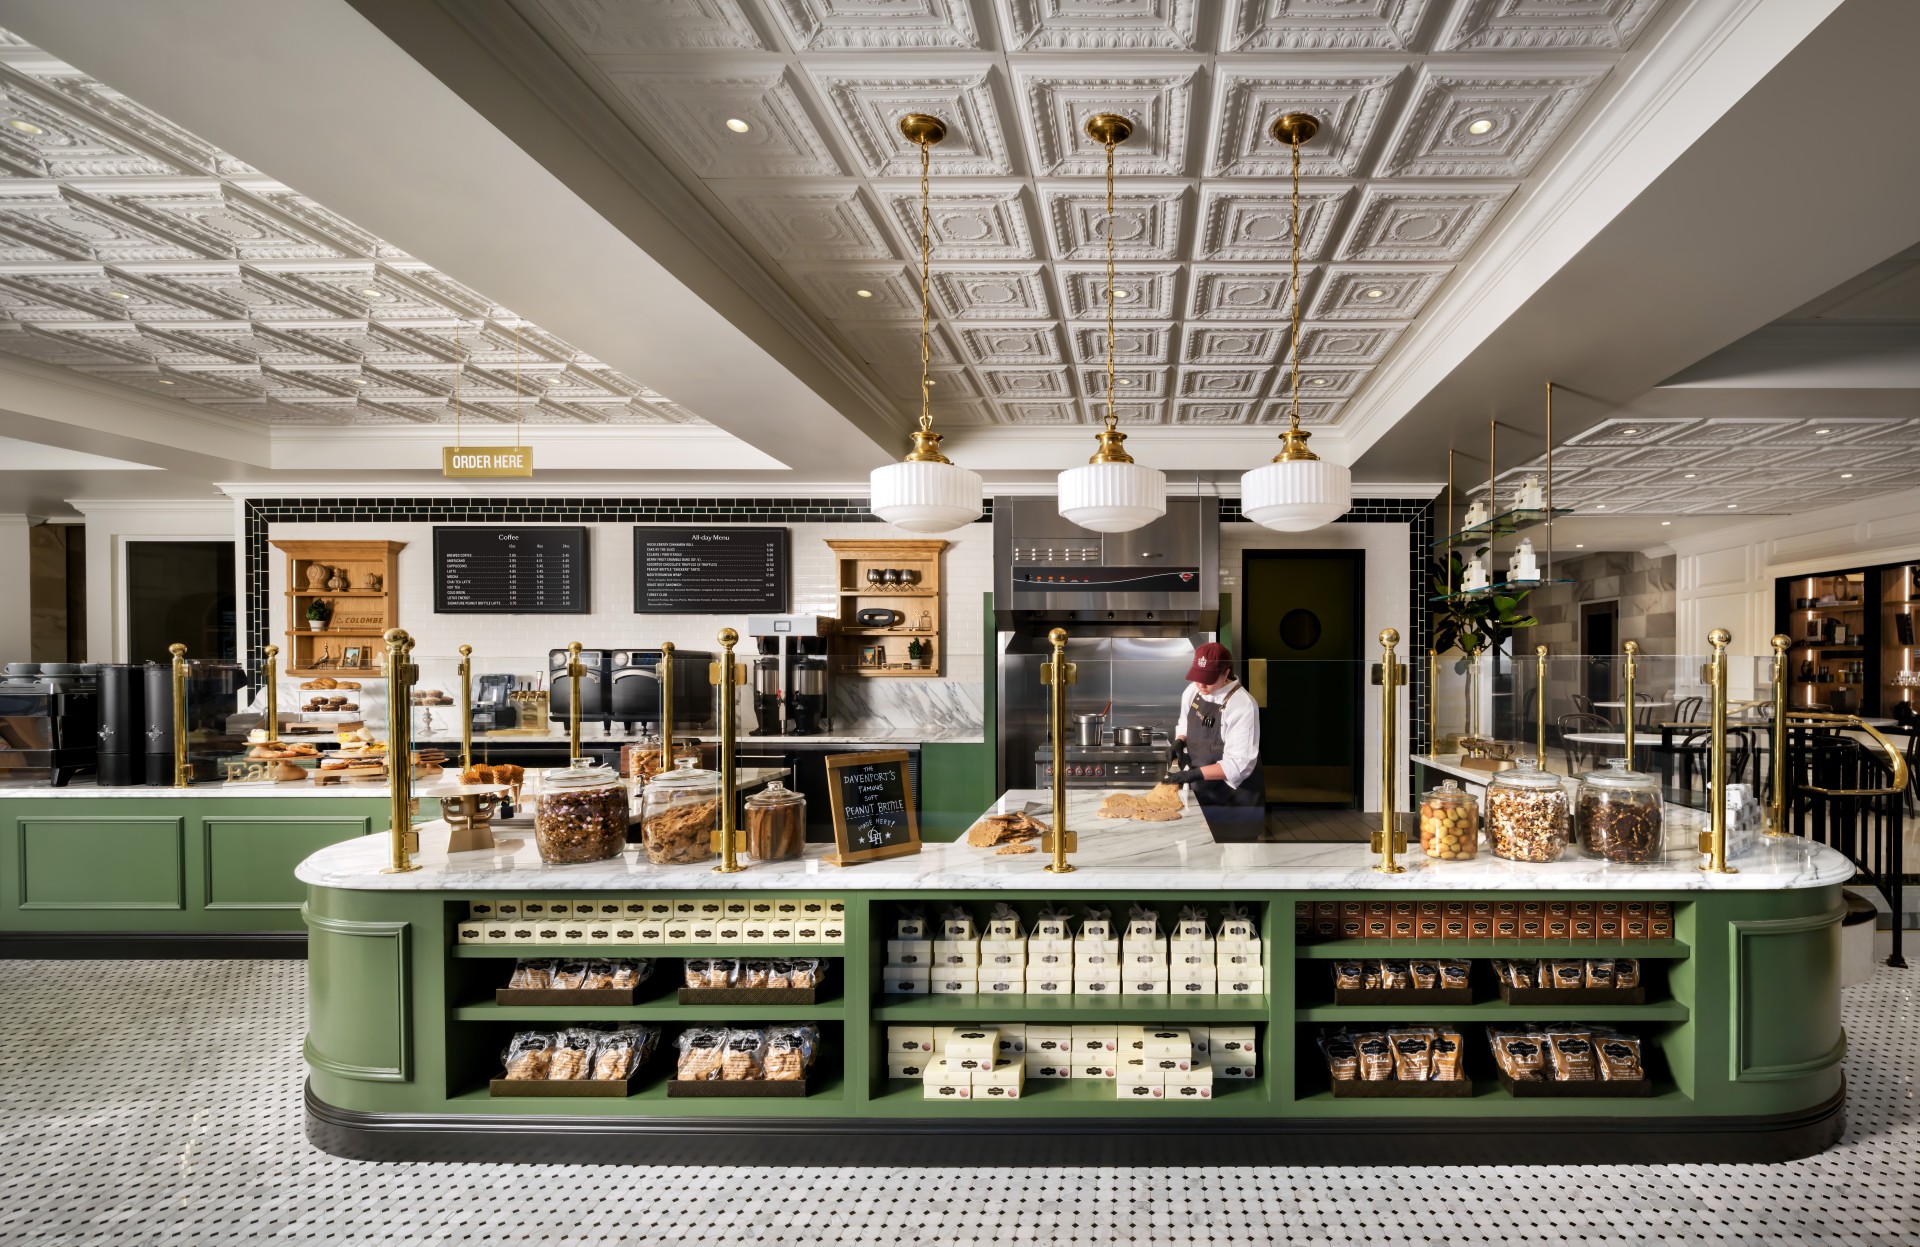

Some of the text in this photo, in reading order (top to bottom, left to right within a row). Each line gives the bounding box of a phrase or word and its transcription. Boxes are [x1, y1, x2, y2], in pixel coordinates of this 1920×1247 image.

[452, 455, 523, 468] ORDER HERE
[843, 770, 896, 784] DAVENPORT'S
[858, 784, 884, 793] FAMOUS
[845, 800, 904, 817] PEANUT BRITTLE
[858, 818, 896, 831] MADE HERE!
